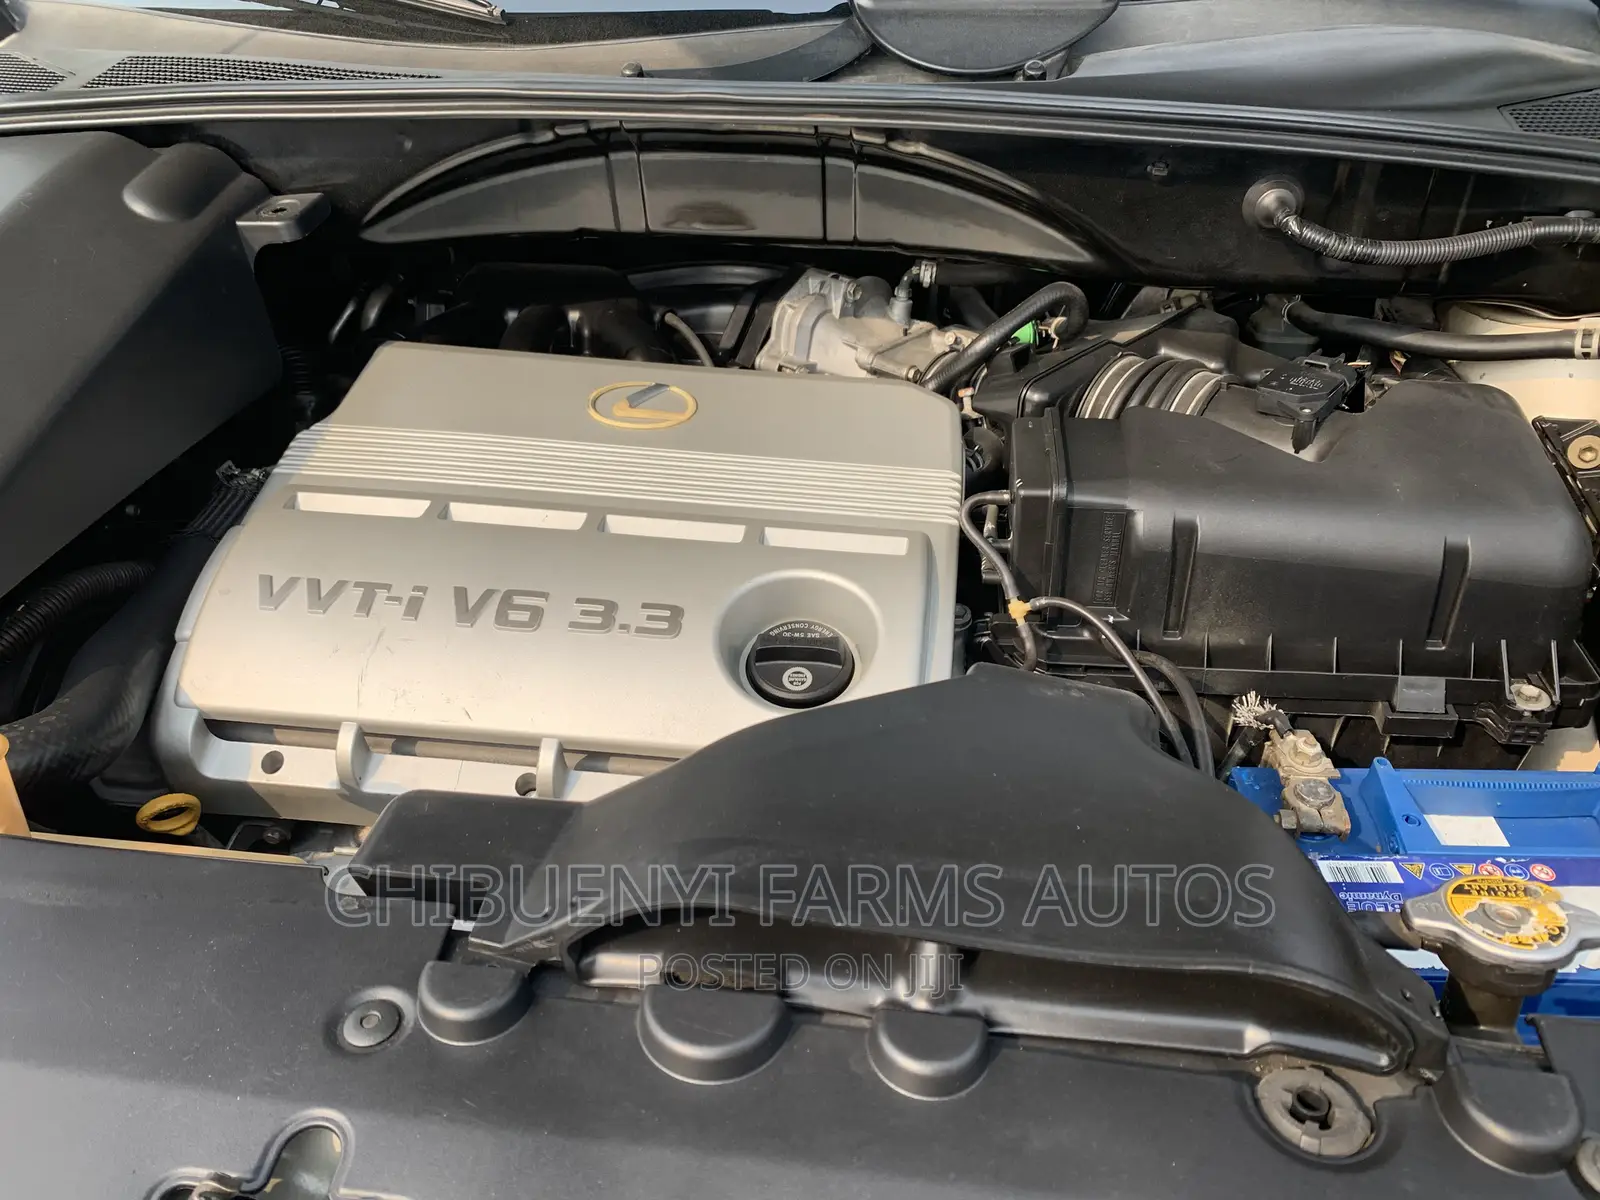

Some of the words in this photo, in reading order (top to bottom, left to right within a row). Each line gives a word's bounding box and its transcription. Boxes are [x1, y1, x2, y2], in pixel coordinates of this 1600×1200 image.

[452, 585, 551, 633] V6
[567, 597, 686, 640] 3.3
[769, 622, 808, 636] CONSERVING
[811, 624, 833, 637] ENERGY
[1463, 883, 1526, 892] COOLANT
[1339, 891, 1403, 903] Dynamic
